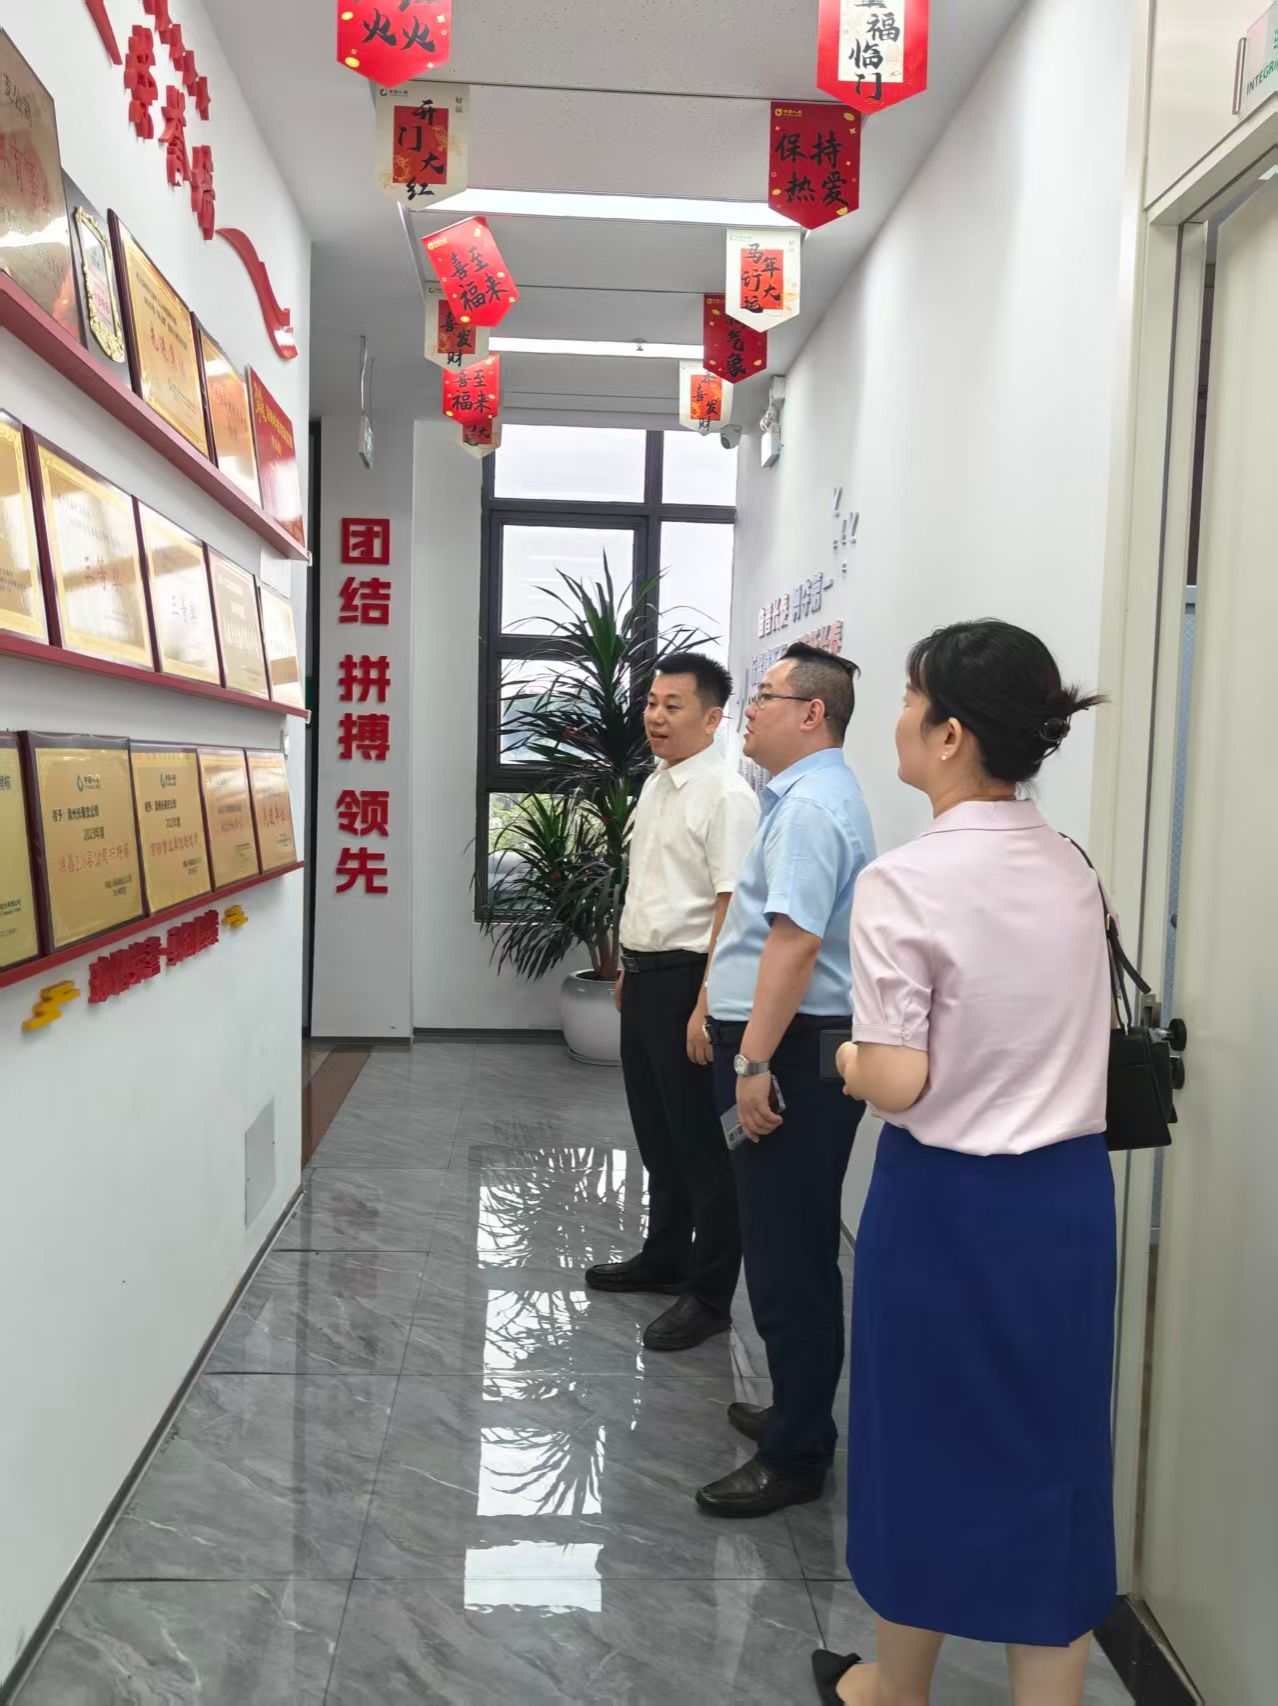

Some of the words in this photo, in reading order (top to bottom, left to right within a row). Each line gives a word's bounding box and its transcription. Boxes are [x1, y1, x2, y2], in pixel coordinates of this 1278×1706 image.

[361, 7, 437, 52] 火火
[774, 128, 843, 169] 保持
[785, 170, 849, 207] 热爱
[458, 272, 509, 312] 福来
[452, 390, 492, 414] 福来
[337, 517, 392, 626] 团结
[337, 654, 391, 761] 拼搏
[336, 788, 390, 894] 领先
